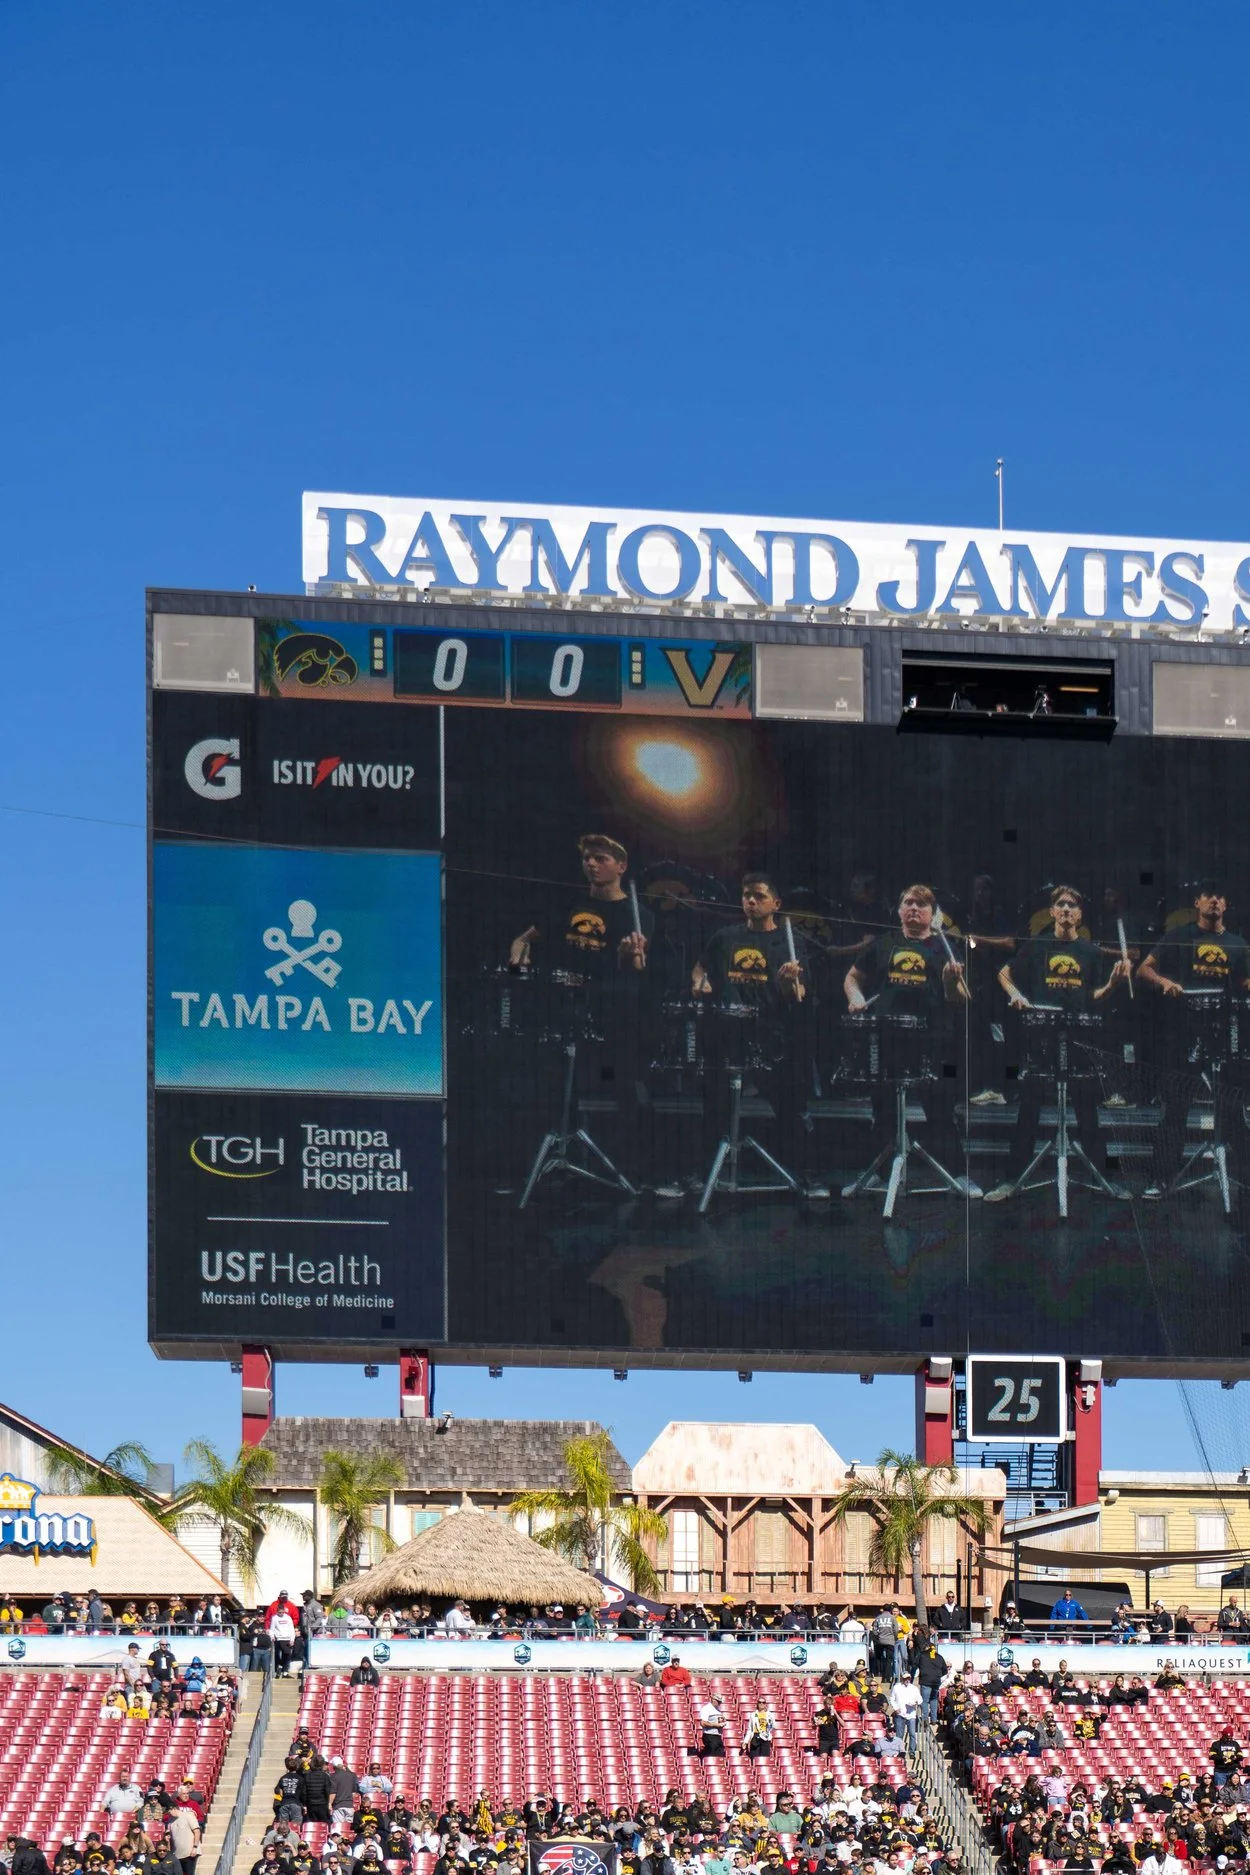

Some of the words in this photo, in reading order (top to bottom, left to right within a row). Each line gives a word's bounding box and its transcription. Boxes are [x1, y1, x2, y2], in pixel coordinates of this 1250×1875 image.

[315, 505, 860, 607] RAYMOND
[875, 537, 1211, 629] JAMES
[433, 638, 468, 691] 0
[550, 645, 585, 697] 0
[184, 738, 242, 800] G
[273, 759, 294, 785] IS
[296, 760, 315, 786] IT
[331, 762, 354, 788] IN
[356, 764, 415, 790] YOU?
[171, 991, 332, 1032] TAMPA
[348, 997, 433, 1035] BAY
[202, 1135, 285, 1166] TGH
[300, 1123, 390, 1150] Tampa
[302, 1146, 402, 1170] General
[302, 1168, 408, 1195] Hospital
[202, 1291, 256, 1305] Morsani
[260, 1292, 311, 1309] College
[316, 1294, 328, 1307] of
[333, 1294, 395, 1309] Medicine
[987, 1377, 1043, 1422] 25
